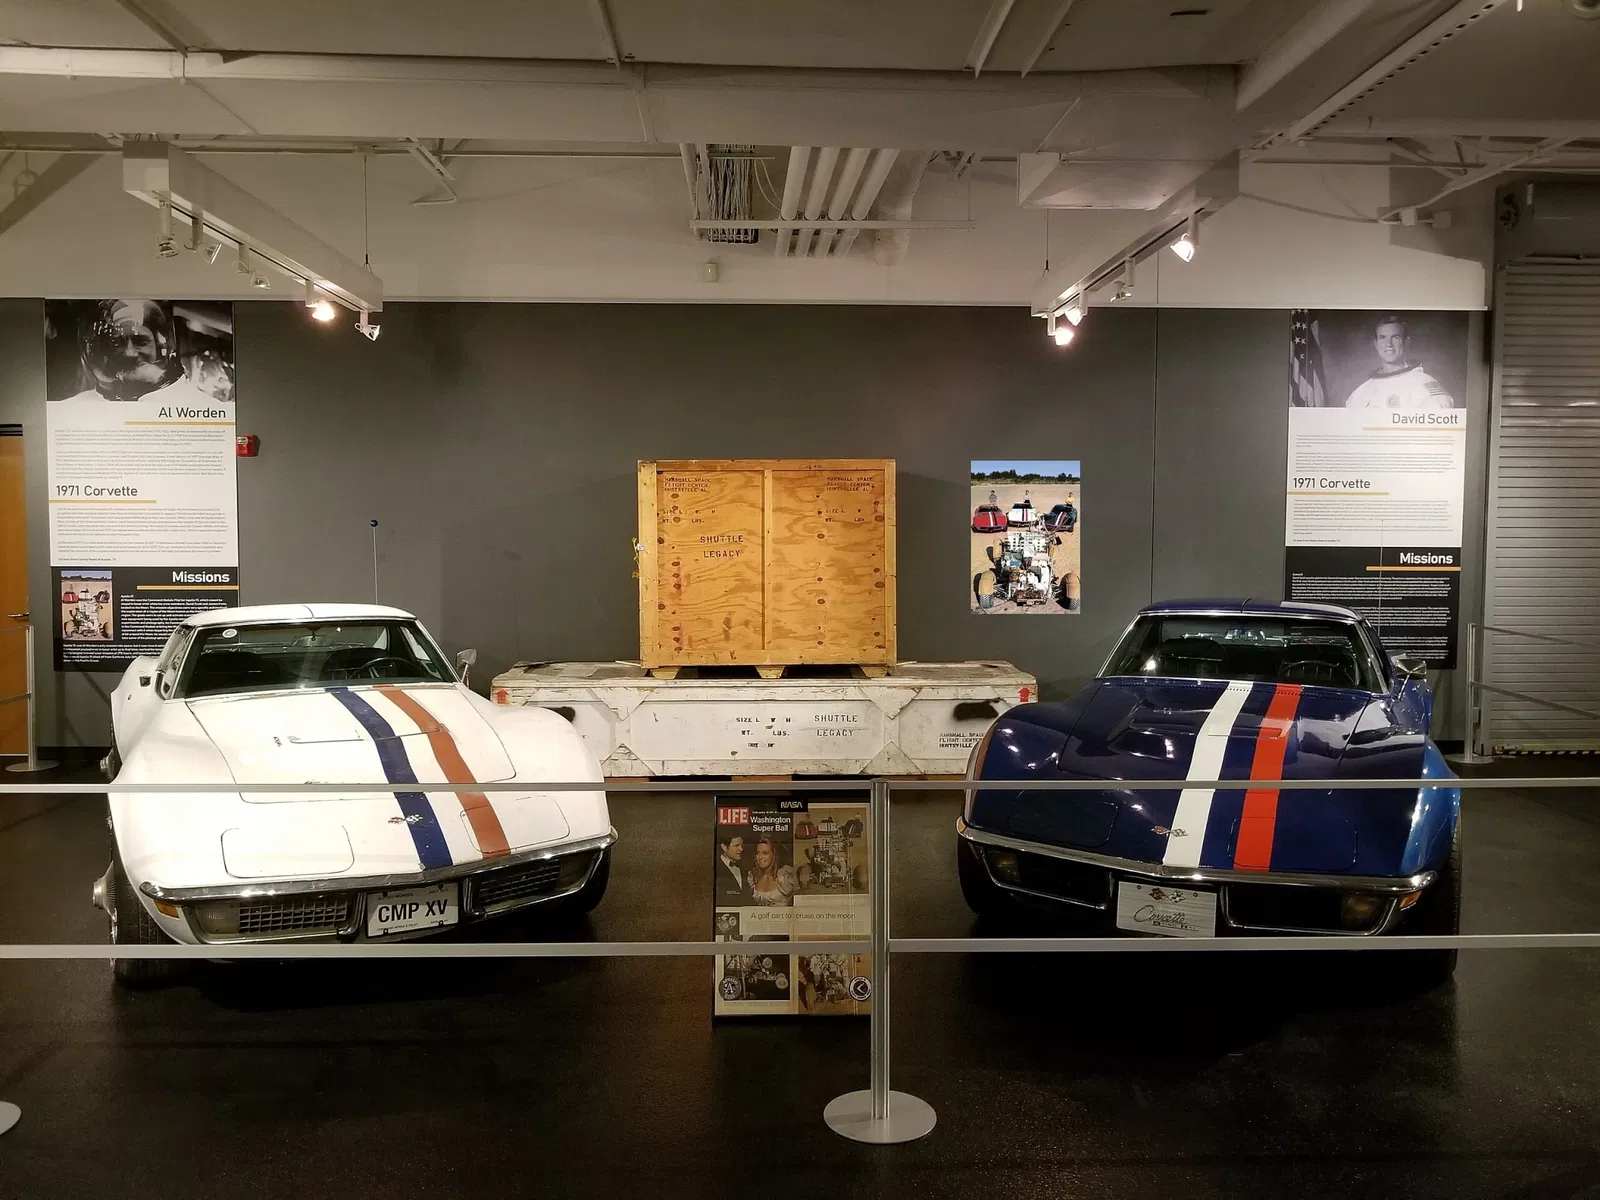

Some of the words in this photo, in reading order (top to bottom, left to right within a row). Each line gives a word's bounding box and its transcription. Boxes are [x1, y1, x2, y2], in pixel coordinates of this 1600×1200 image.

[158, 407, 172, 418] Al
[176, 407, 226, 418] Worden
[1392, 413, 1425, 424] David
[1427, 413, 1458, 424] Scott
[1293, 477, 1316, 489] 1971
[1319, 477, 1371, 489] Corvette
[56, 485, 80, 496] 1971
[84, 485, 138, 496] Corvette
[700, 535, 744, 543] SHUTTLE
[703, 549, 741, 558] LEGACY
[1400, 552, 1453, 564] Missions
[172, 571, 230, 583] Missions
[814, 714, 858, 723] SHUTTLE
[816, 729, 854, 737] LEGACY
[780, 801, 803, 809] NASA
[719, 808, 748, 824] LIFE
[750, 815, 791, 825] Washington
[752, 824, 774, 833] Super
[775, 824, 789, 832] Ball
[378, 902, 420, 923] CMP
[425, 898, 448, 917] XV
[757, 912, 770, 920] golf
[1133, 904, 1186, 923] Corvette
